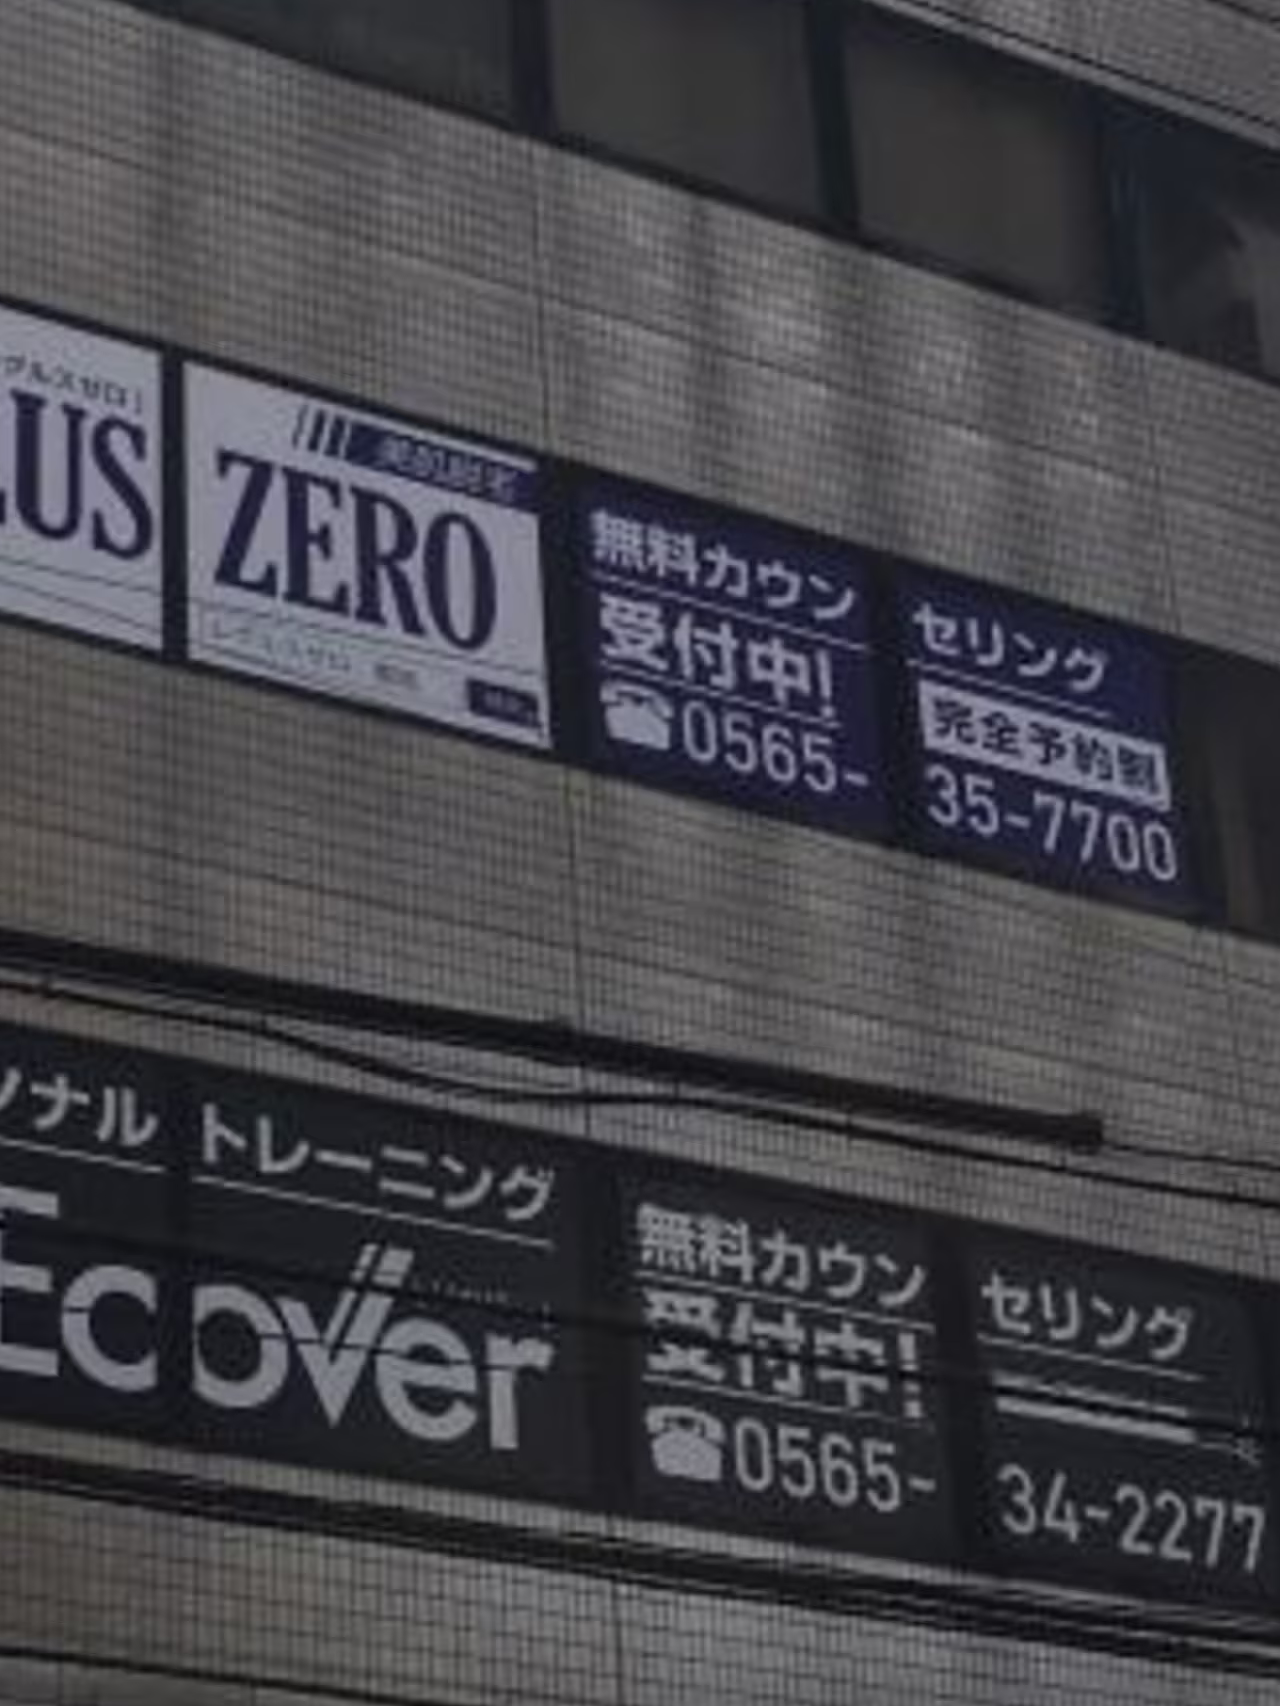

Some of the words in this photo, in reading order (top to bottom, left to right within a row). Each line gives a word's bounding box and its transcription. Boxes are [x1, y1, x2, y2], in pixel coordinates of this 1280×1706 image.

[213, 447, 498, 652] ZERO
[589, 507, 856, 621] 無料カウン
[912, 601, 1107, 693] セリング
[924, 763, 1178, 883] 35-7700
[201, 1101, 556, 1222] トレーニング
[635, 1199, 928, 1307] 無料カウン
[980, 1272, 1195, 1361] セリング
[995, 1463, 1269, 1575] 34-2277
